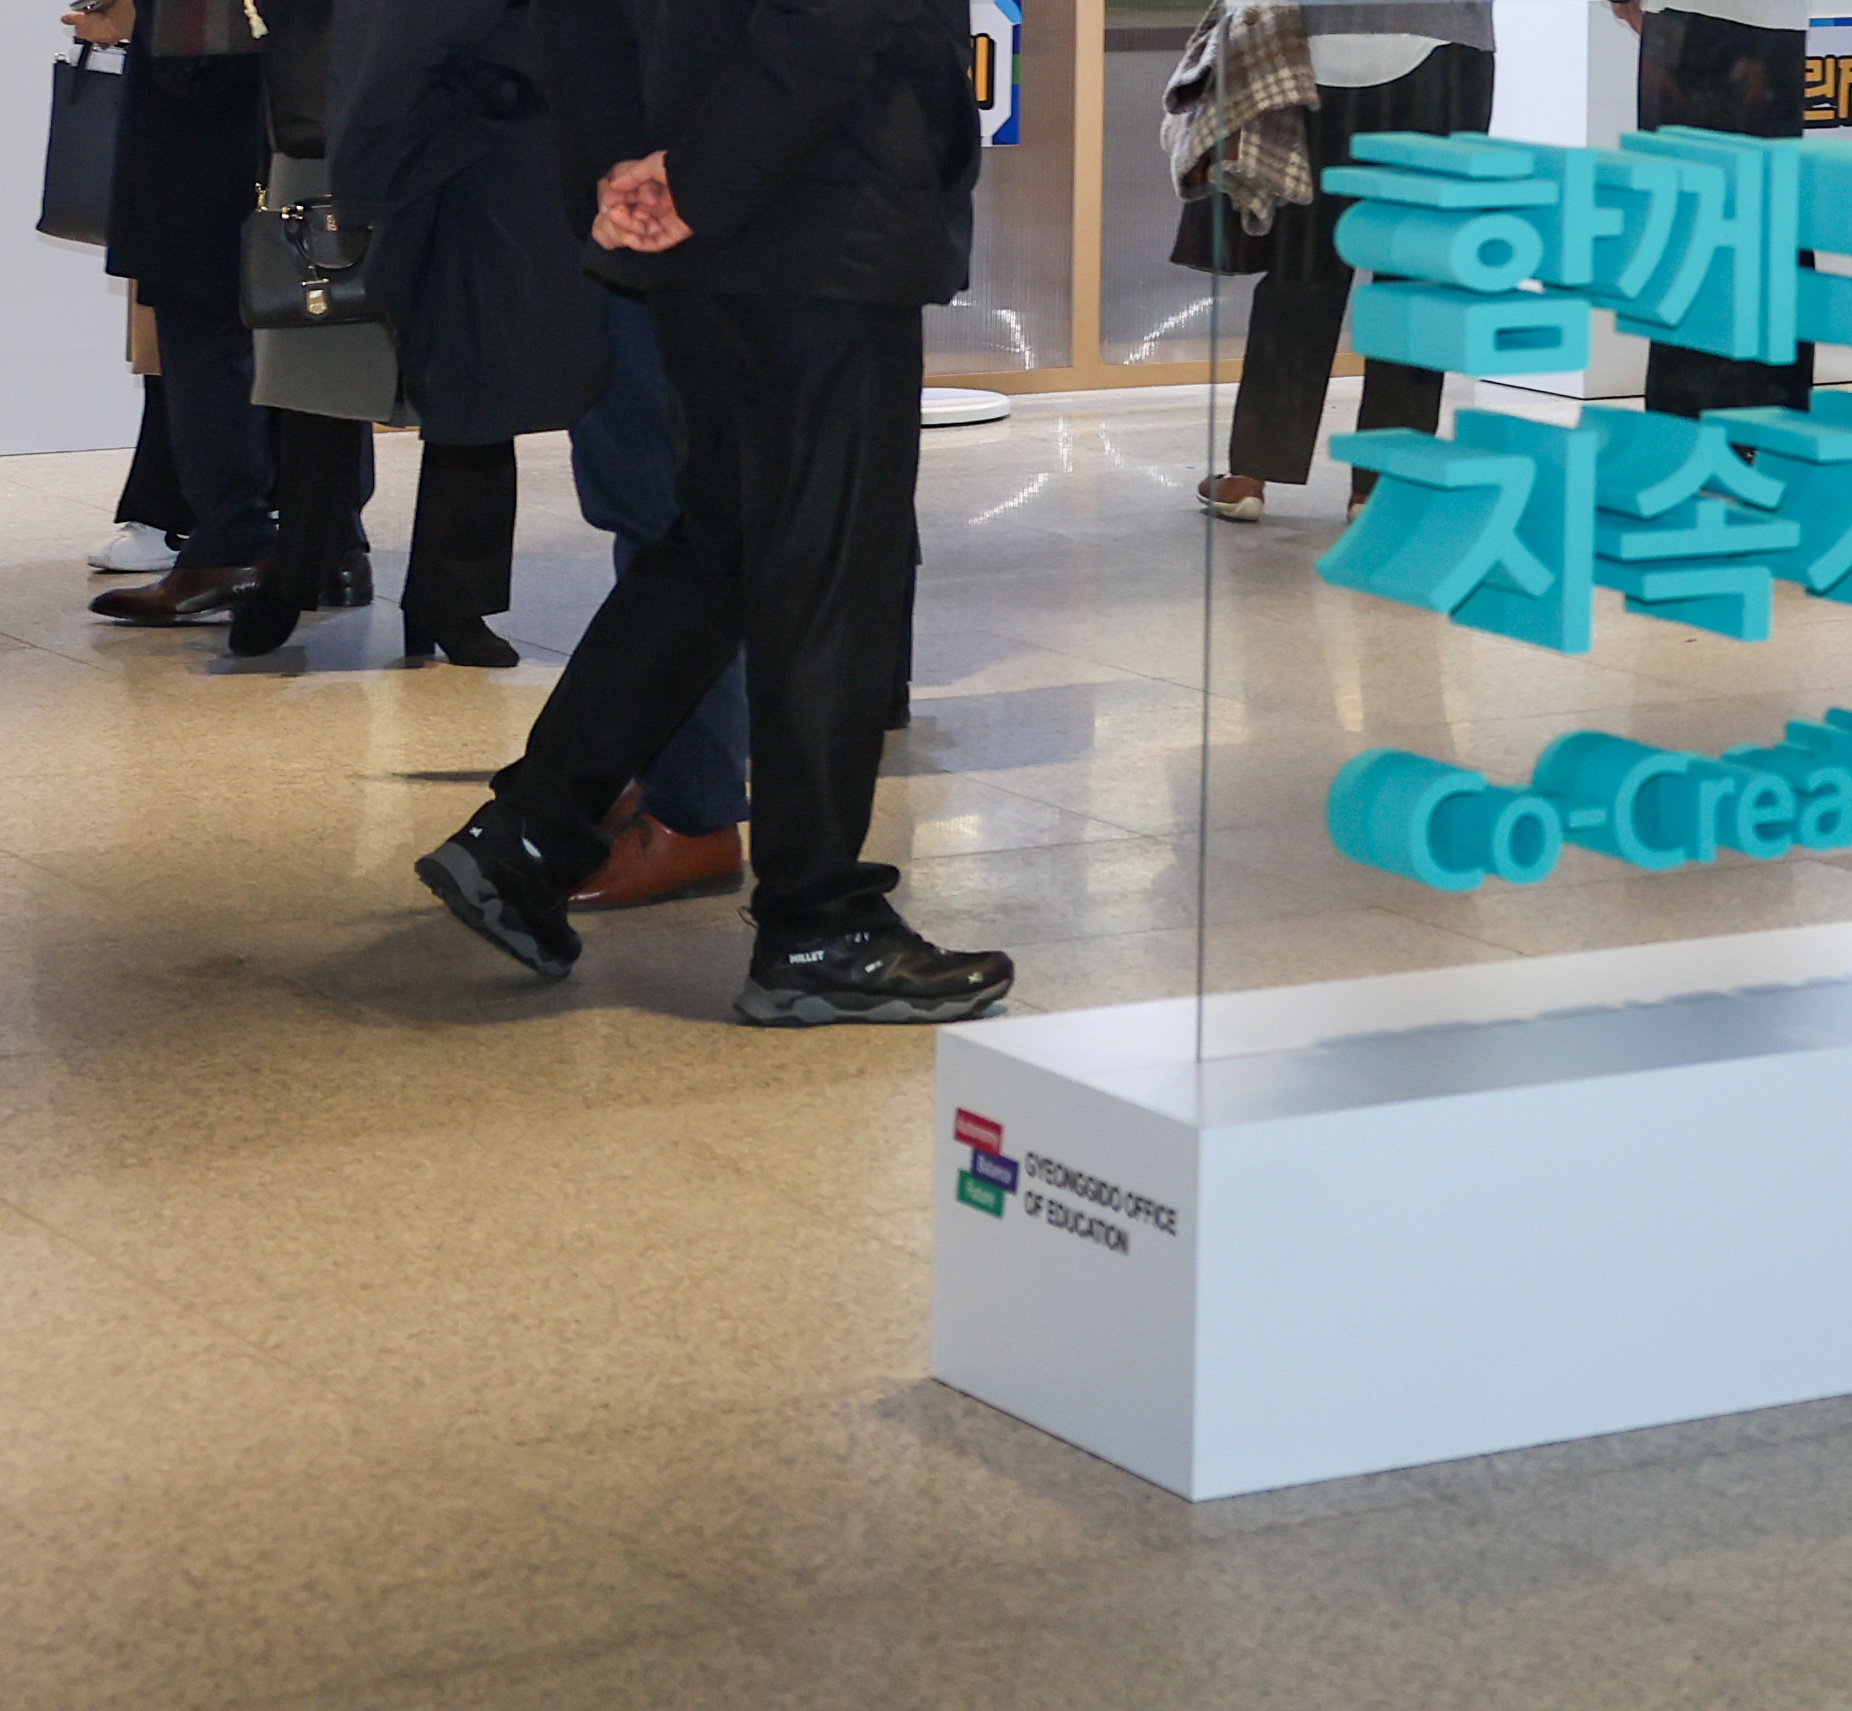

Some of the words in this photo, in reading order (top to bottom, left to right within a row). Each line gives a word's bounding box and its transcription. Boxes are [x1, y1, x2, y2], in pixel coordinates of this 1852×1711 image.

[1320, 126, 1798, 376] 함께
[1024, 1150, 1123, 1213] GYEONGGIDO
[1123, 1191, 1179, 1237] OFFICE
[1024, 1190, 1043, 1218] OF
[1046, 1199, 1130, 1257] EDUCATION
